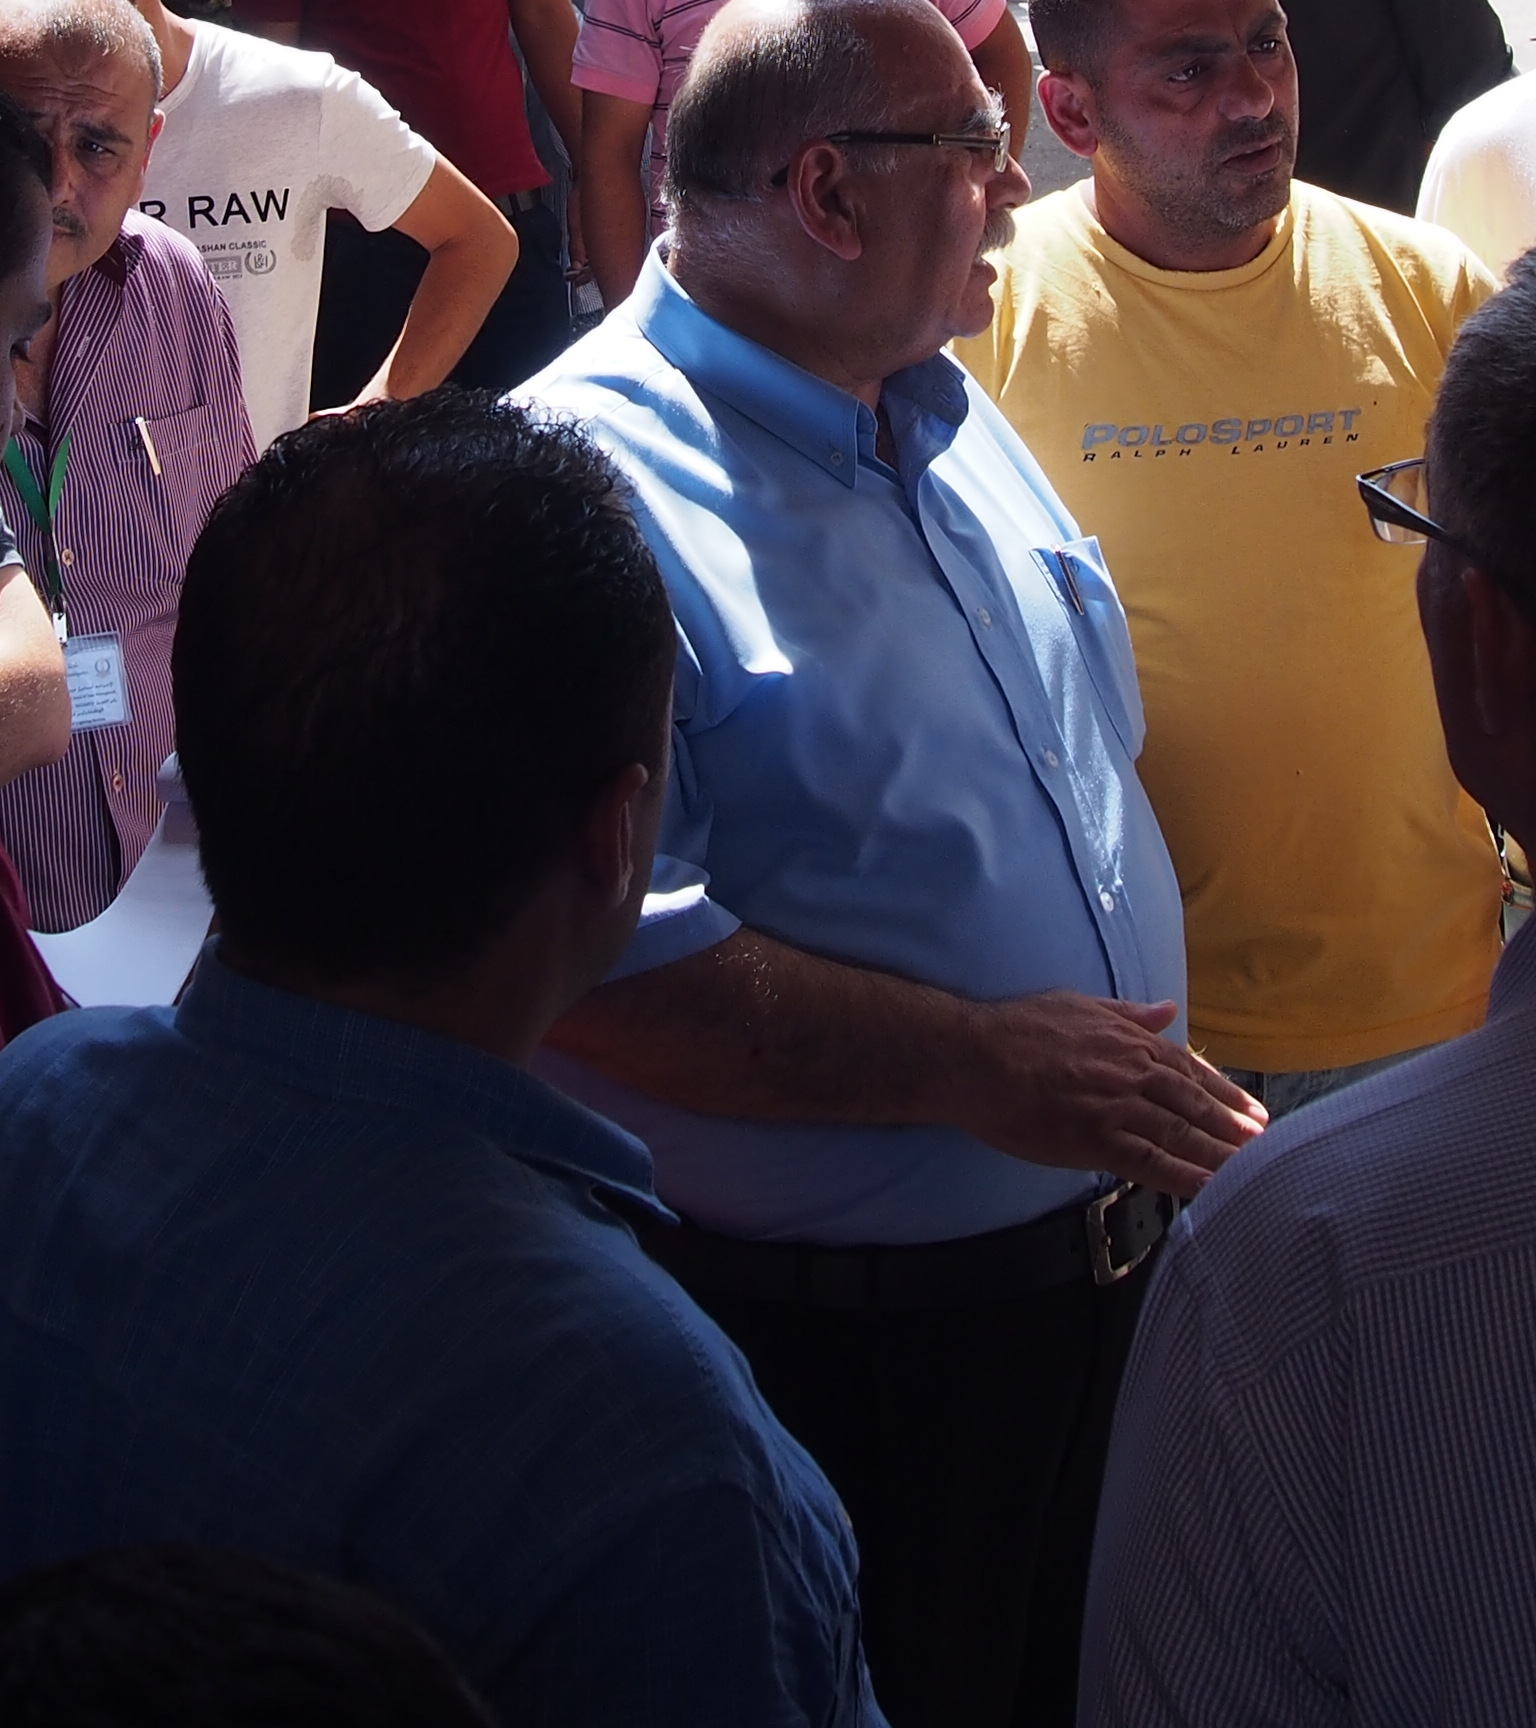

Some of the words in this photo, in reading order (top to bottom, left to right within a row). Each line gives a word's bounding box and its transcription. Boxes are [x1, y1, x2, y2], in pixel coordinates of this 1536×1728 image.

[187, 187, 290, 229] RAW
[229, 240, 267, 251] CLASSIC
[1082, 447, 1192, 463] RALPH
[1230, 433, 1360, 455] LAUREN
